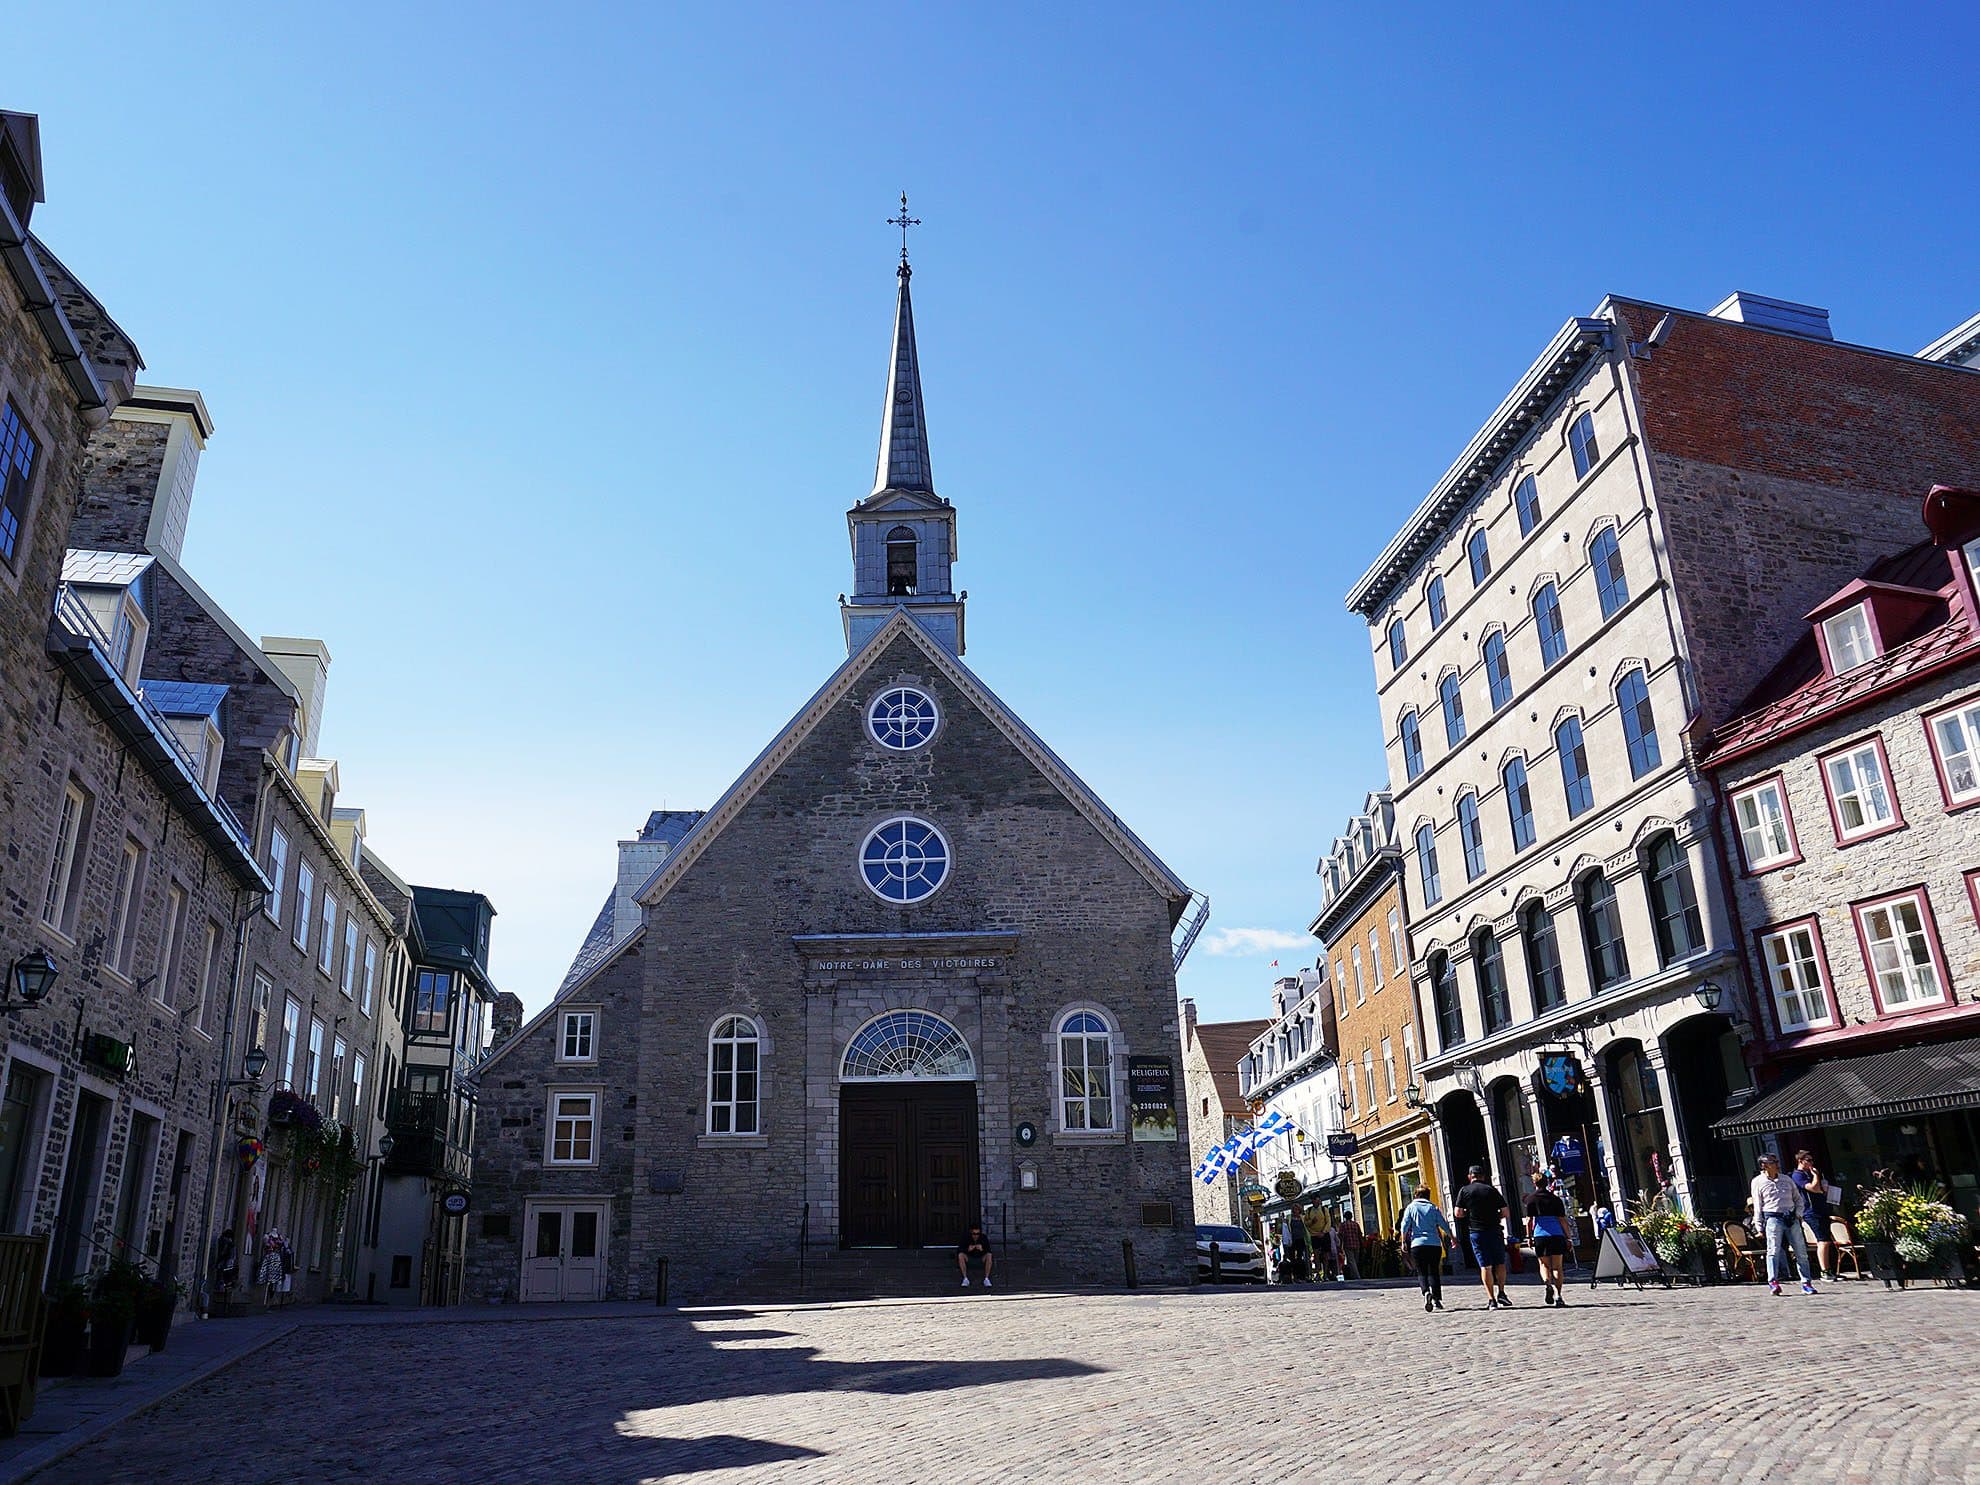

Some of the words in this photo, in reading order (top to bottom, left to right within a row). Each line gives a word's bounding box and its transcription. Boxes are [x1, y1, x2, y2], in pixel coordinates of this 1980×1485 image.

[819, 961, 890, 970] NOTRE-DAME
[900, 960, 921, 969] DES
[932, 959, 996, 968] VICTOIRES
[1131, 1069, 1170, 1077] RELIGIEUX
